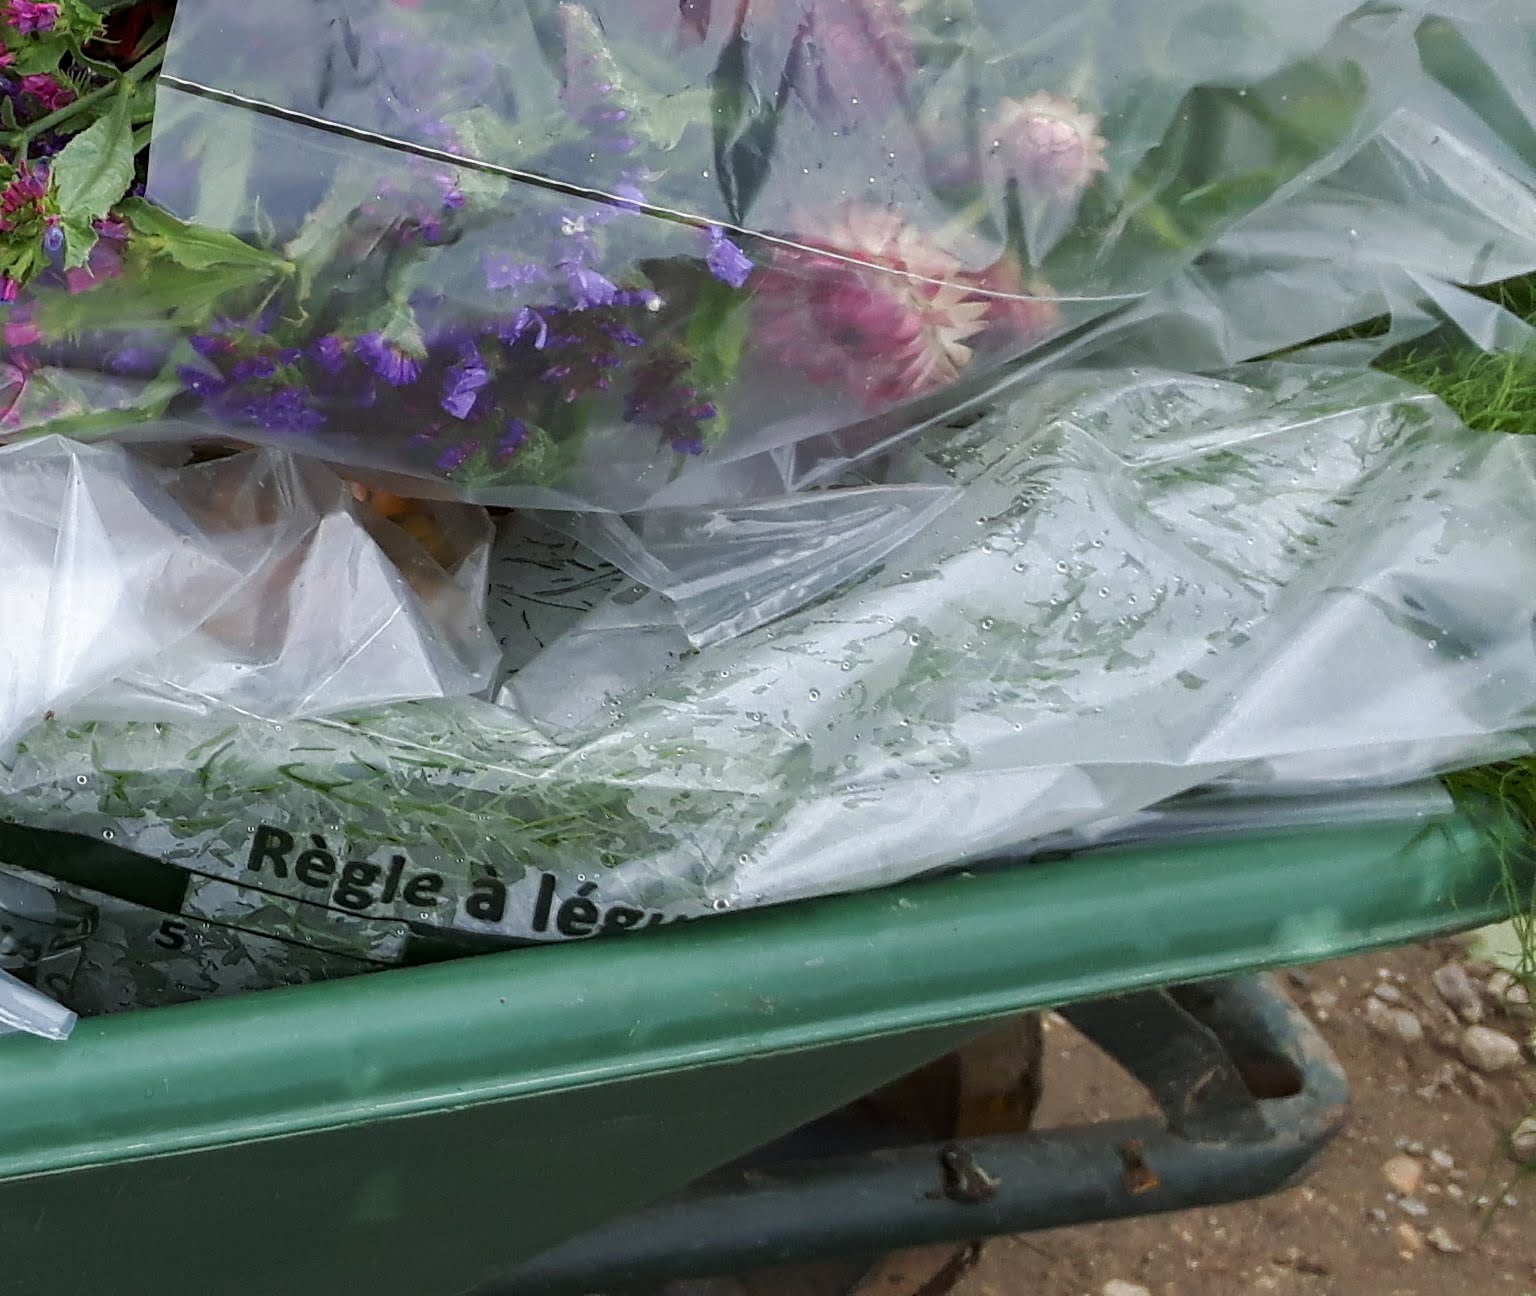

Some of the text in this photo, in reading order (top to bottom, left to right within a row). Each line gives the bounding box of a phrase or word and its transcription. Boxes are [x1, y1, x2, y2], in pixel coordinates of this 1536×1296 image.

[246, 823, 445, 910] Règle
[465, 862, 508, 923] à
[154, 920, 188, 950] 5
